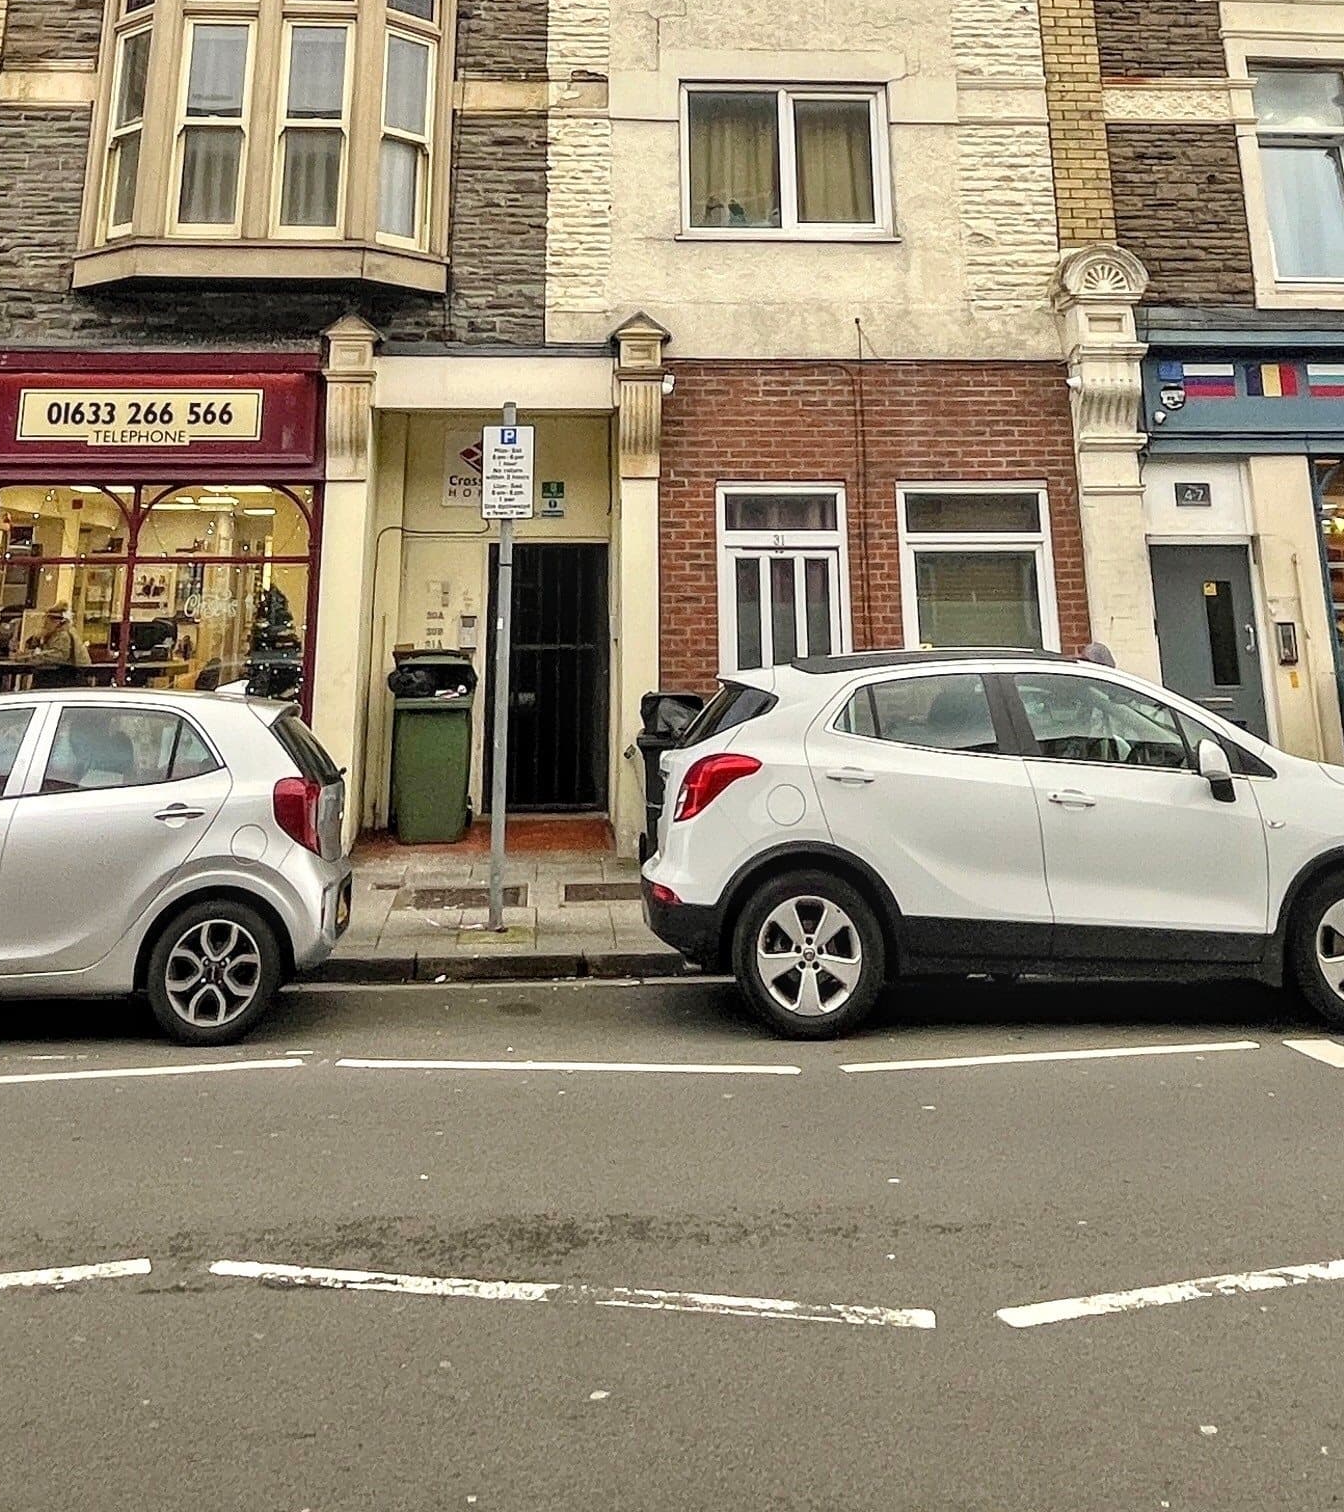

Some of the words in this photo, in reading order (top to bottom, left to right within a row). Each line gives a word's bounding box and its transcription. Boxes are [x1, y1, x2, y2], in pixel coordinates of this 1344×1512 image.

[47, 402, 116, 426] 01633
[127, 402, 174, 426] 266
[187, 402, 233, 426] 566
[92, 430, 187, 444] TELEPHONE
[448, 488, 482, 498] HO
